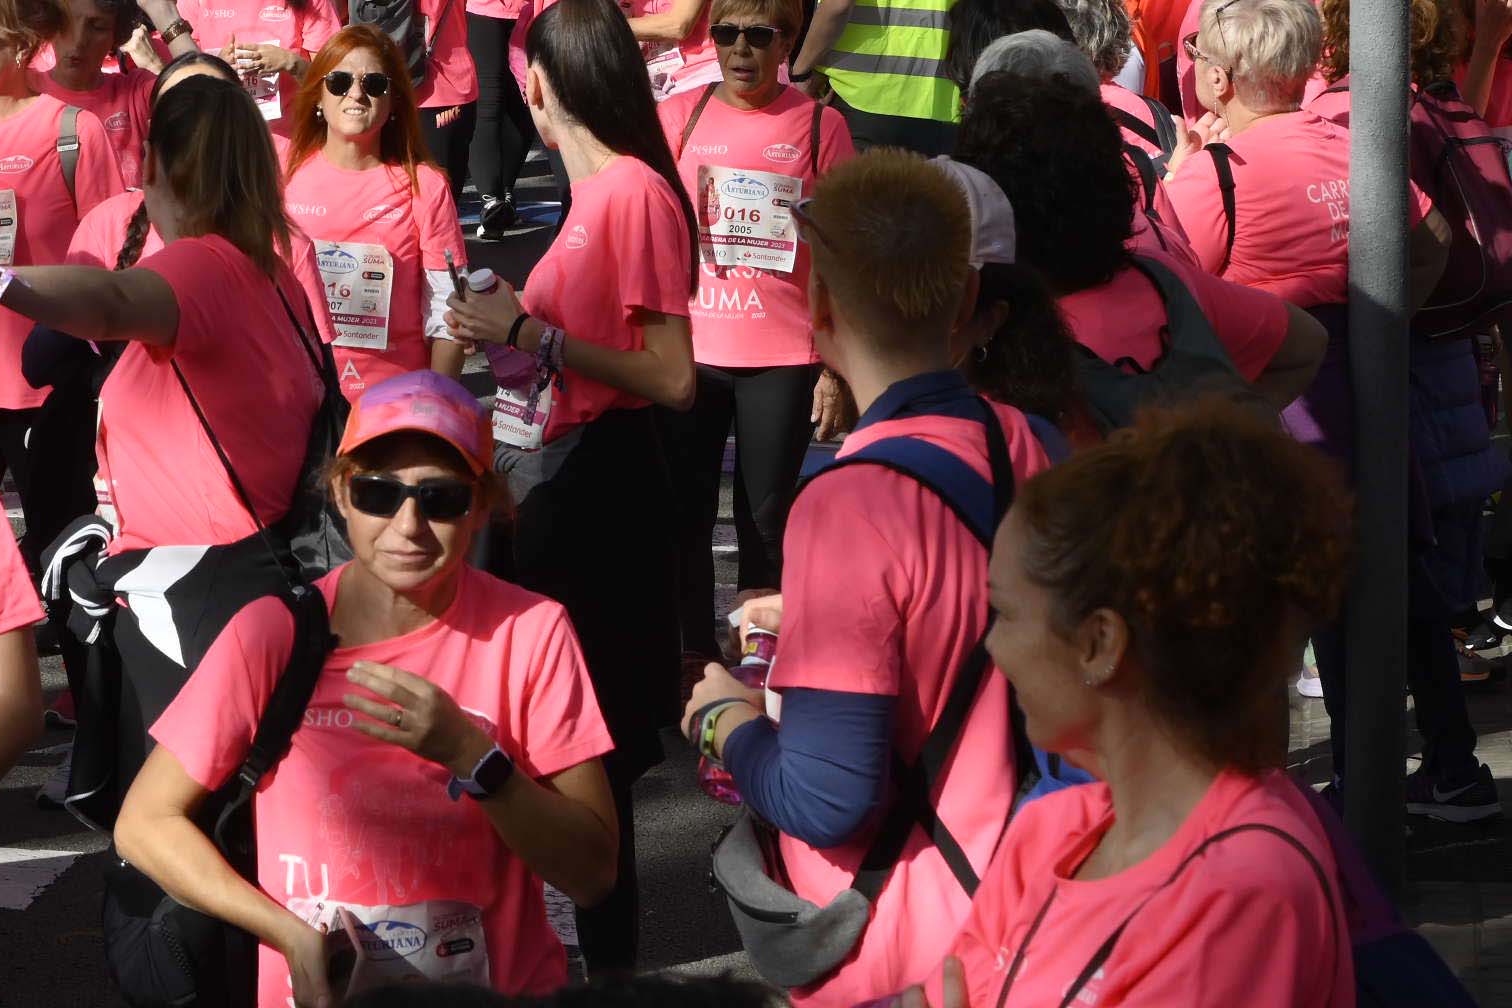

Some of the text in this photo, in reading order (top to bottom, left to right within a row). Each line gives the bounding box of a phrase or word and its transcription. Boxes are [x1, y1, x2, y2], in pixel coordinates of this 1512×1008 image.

[436, 106, 462, 129] NIKE
[1307, 179, 1349, 203] CARR
[724, 206, 761, 223] 016
[729, 224, 752, 235] 2005
[752, 251, 787, 263] Santander
[326, 282, 351, 299] 16
[697, 287, 763, 311] UMA
[343, 330, 380, 340] Santander
[498, 420, 533, 439] Santander
[279, 853, 329, 899] TU
